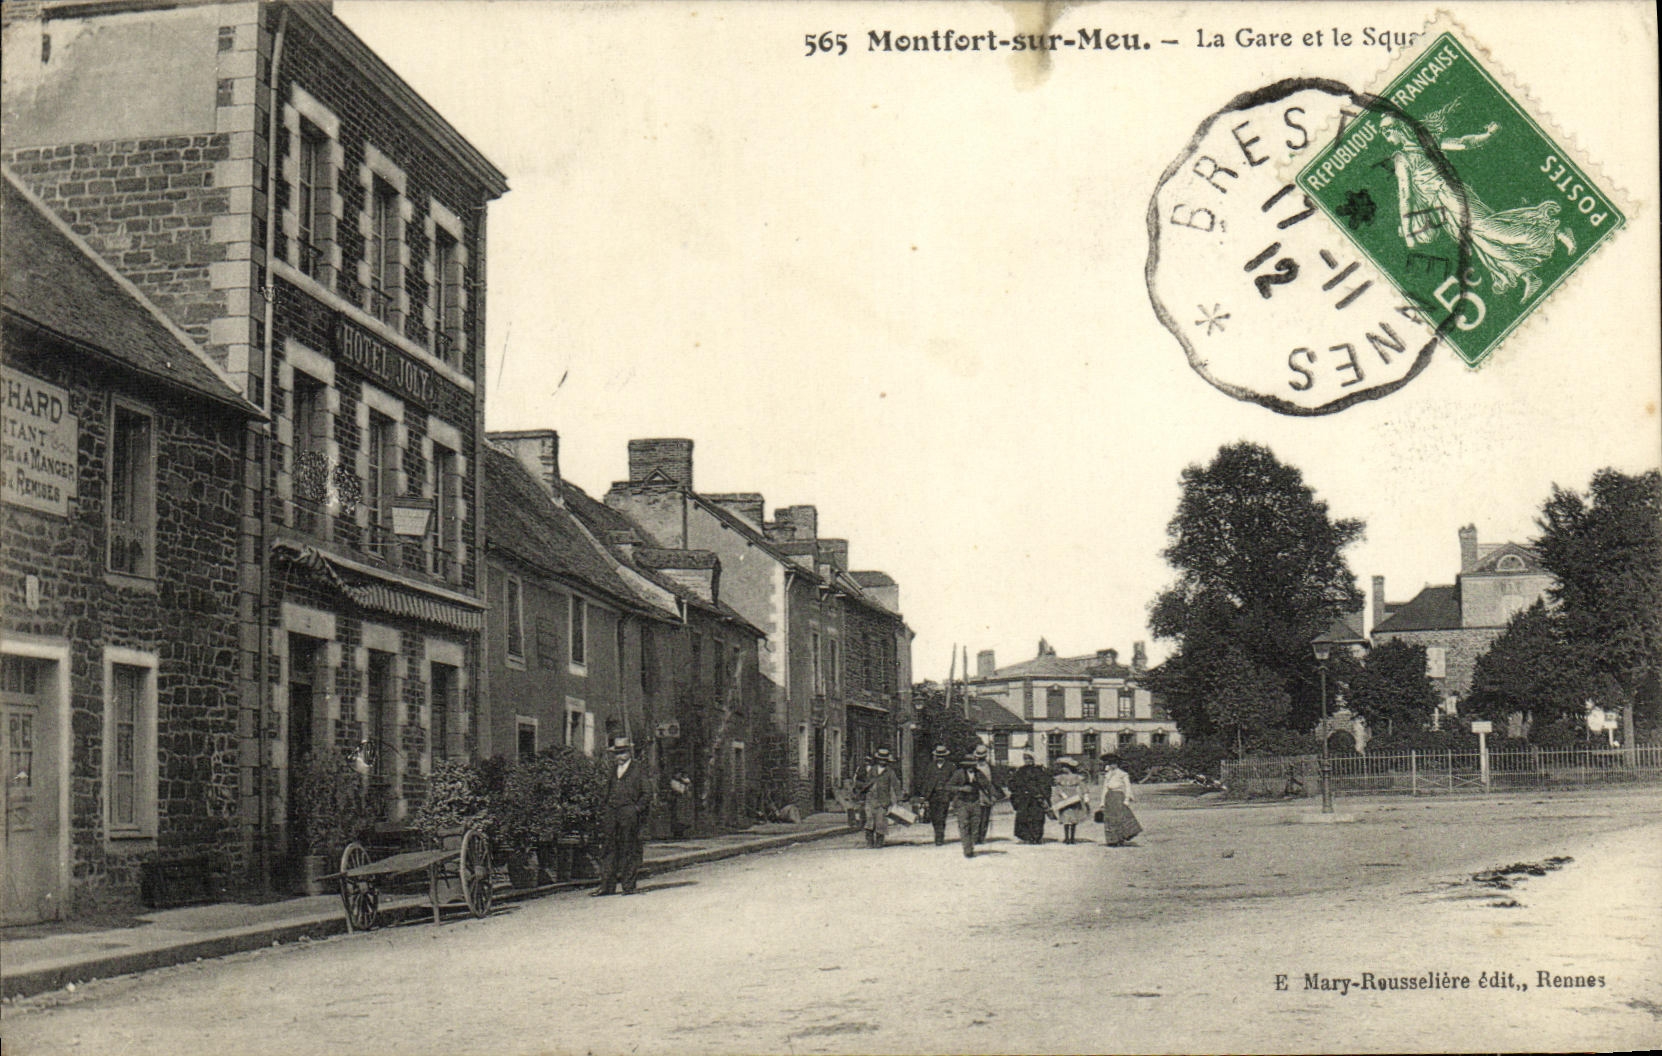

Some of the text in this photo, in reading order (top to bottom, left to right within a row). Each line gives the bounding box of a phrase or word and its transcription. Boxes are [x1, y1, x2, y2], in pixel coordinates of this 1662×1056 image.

[1540, 155, 1608, 227] POSTES
[343, 323, 431, 401] HOTEL JOLY
